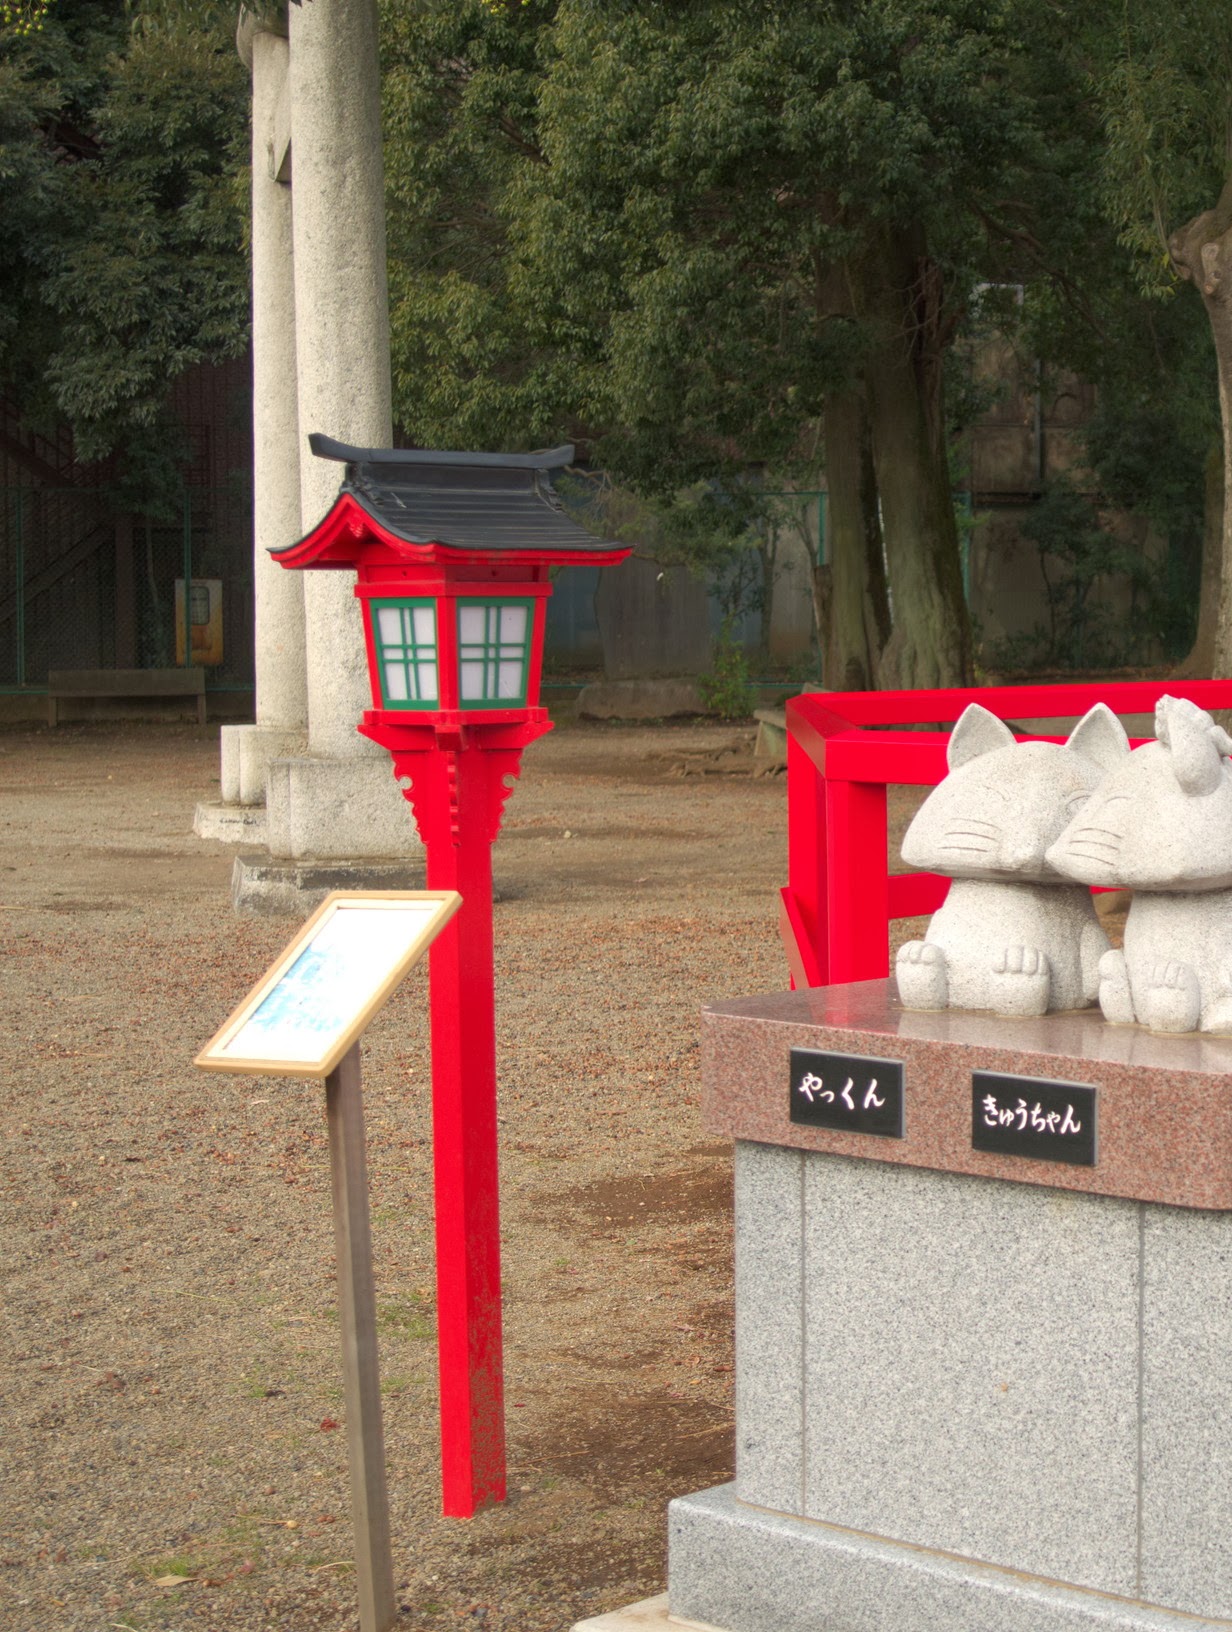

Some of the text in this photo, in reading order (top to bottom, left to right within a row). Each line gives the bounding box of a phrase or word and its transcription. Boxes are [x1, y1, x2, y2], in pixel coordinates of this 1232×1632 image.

[798, 1072, 886, 1110] やっくん
[982, 1093, 1082, 1135] きゅうちゃん
